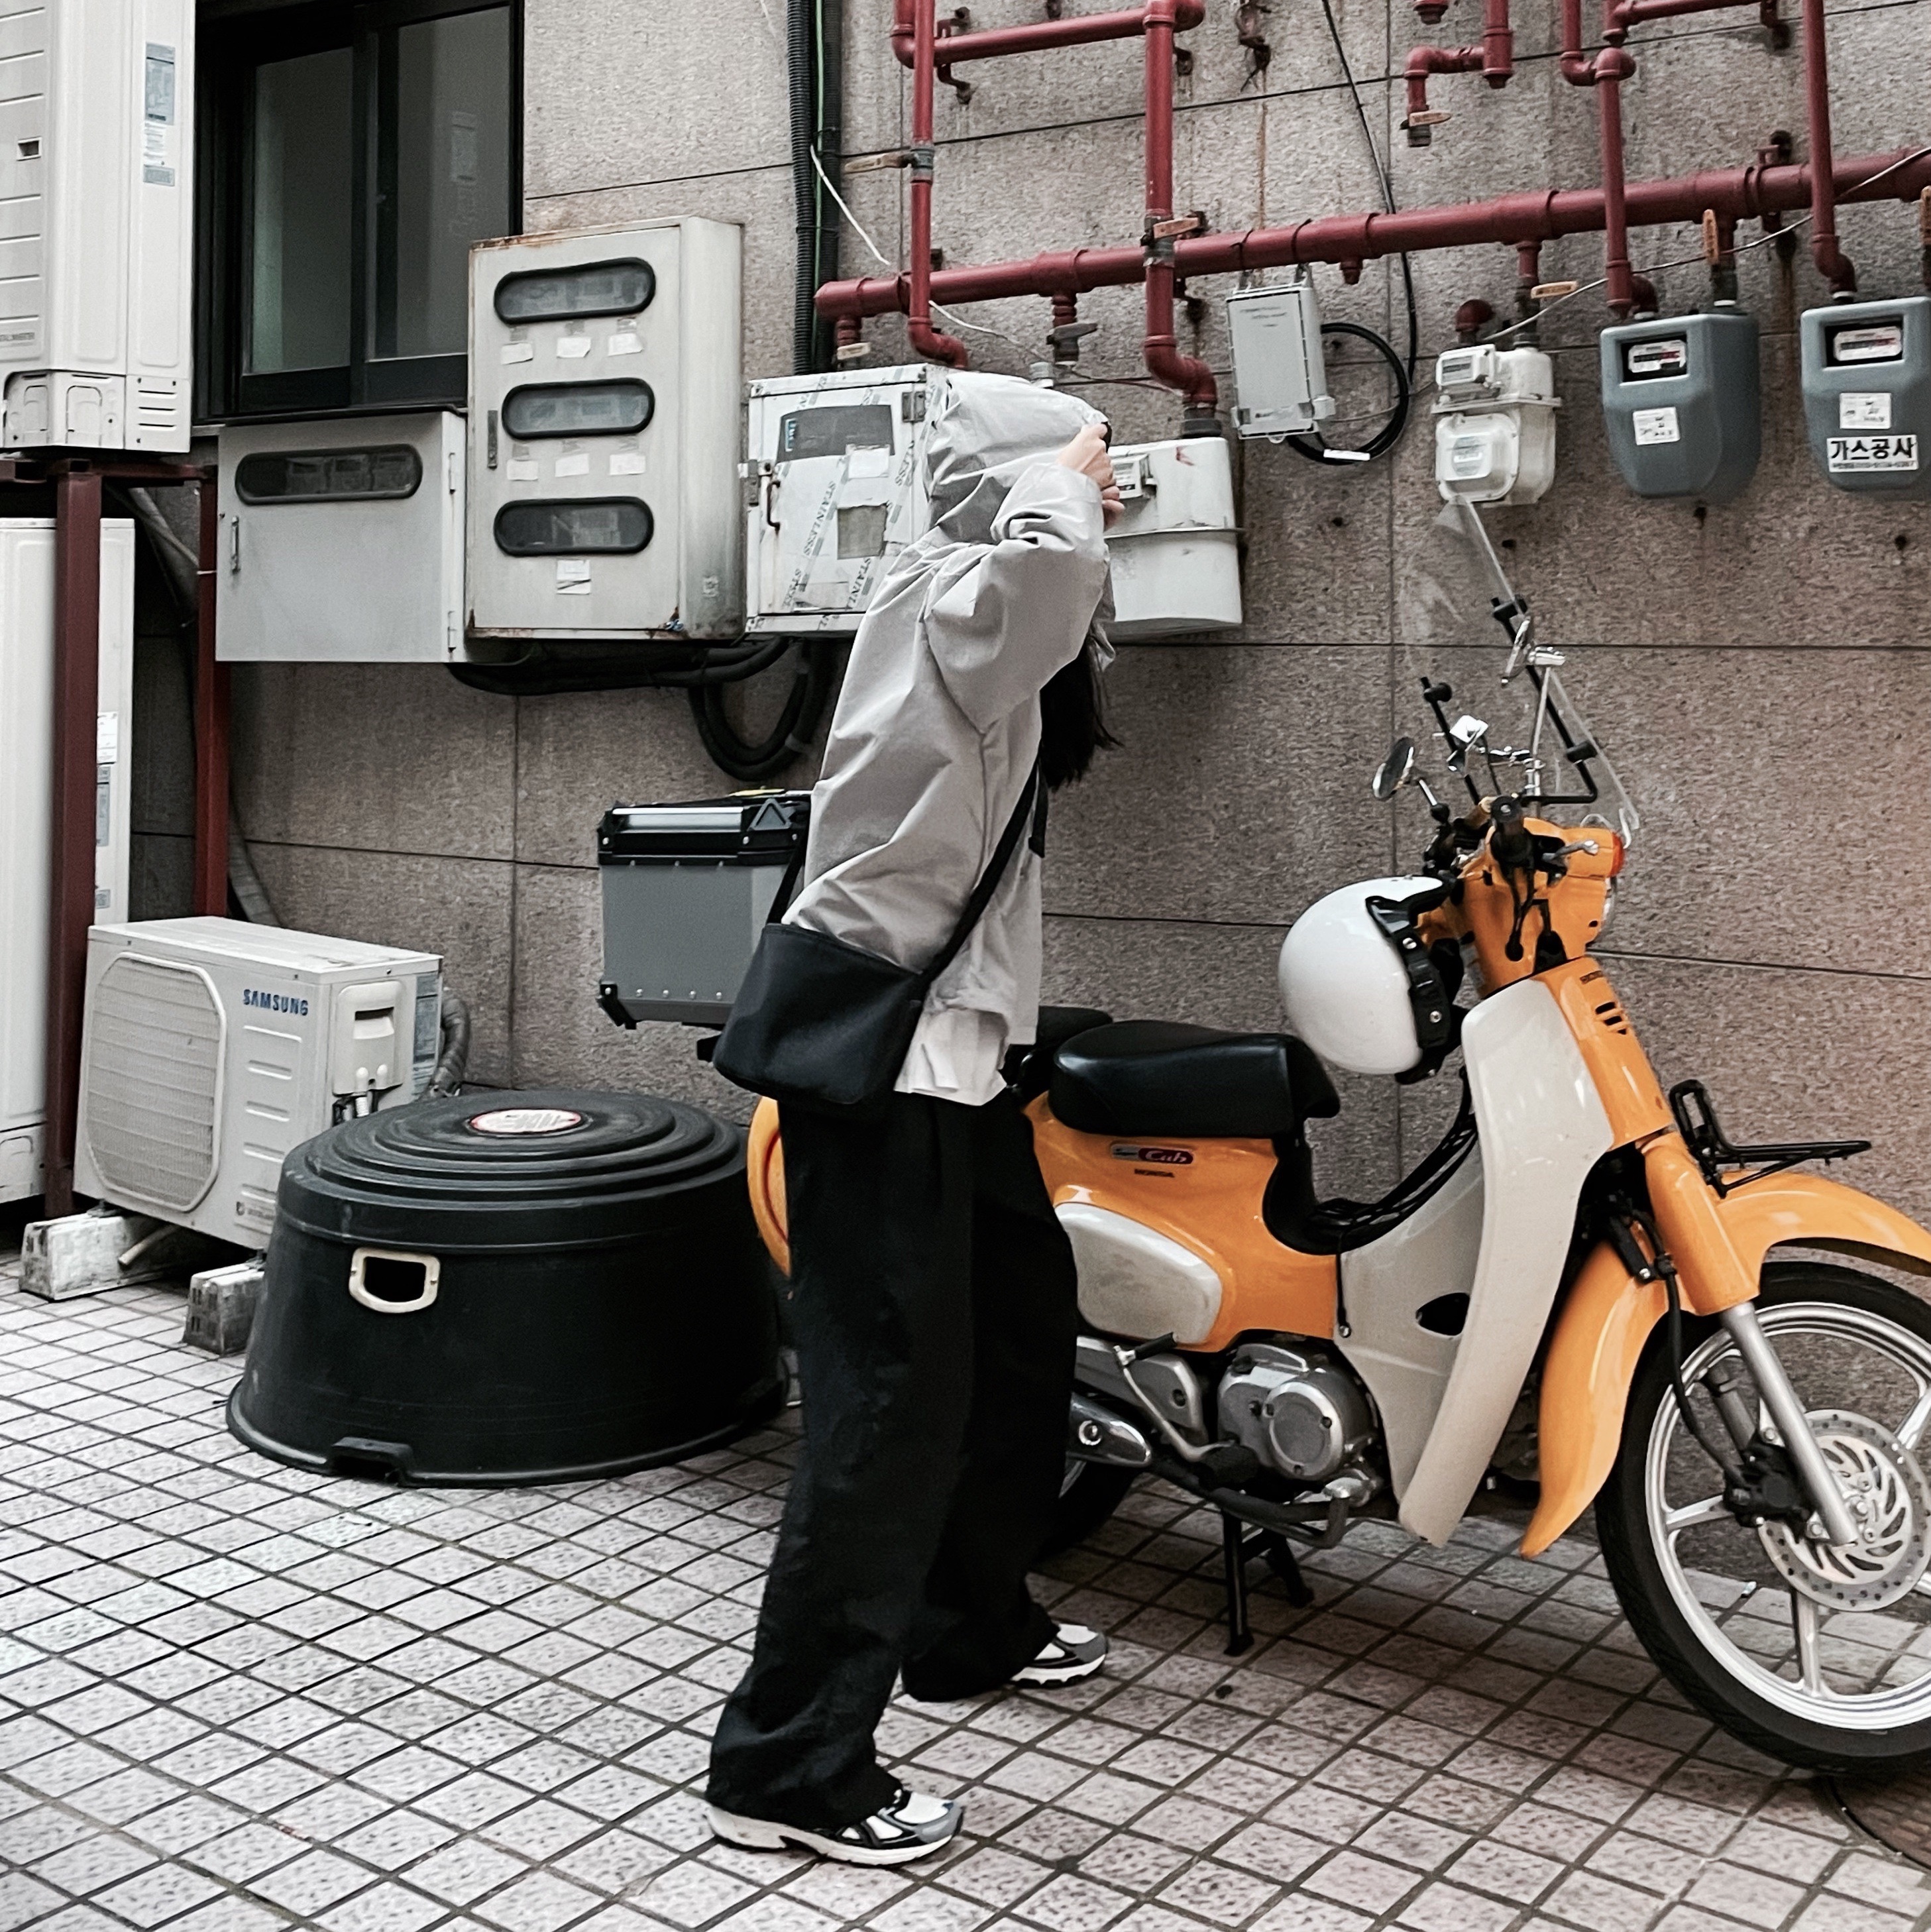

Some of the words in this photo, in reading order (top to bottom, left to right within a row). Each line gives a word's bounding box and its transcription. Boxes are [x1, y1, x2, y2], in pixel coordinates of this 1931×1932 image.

[1830, 437, 1916, 461] 가스공사
[802, 480, 836, 556] STAINLESS
[243, 989, 309, 1016] SAMSUNG
[1145, 1150, 1187, 1163] Cub
